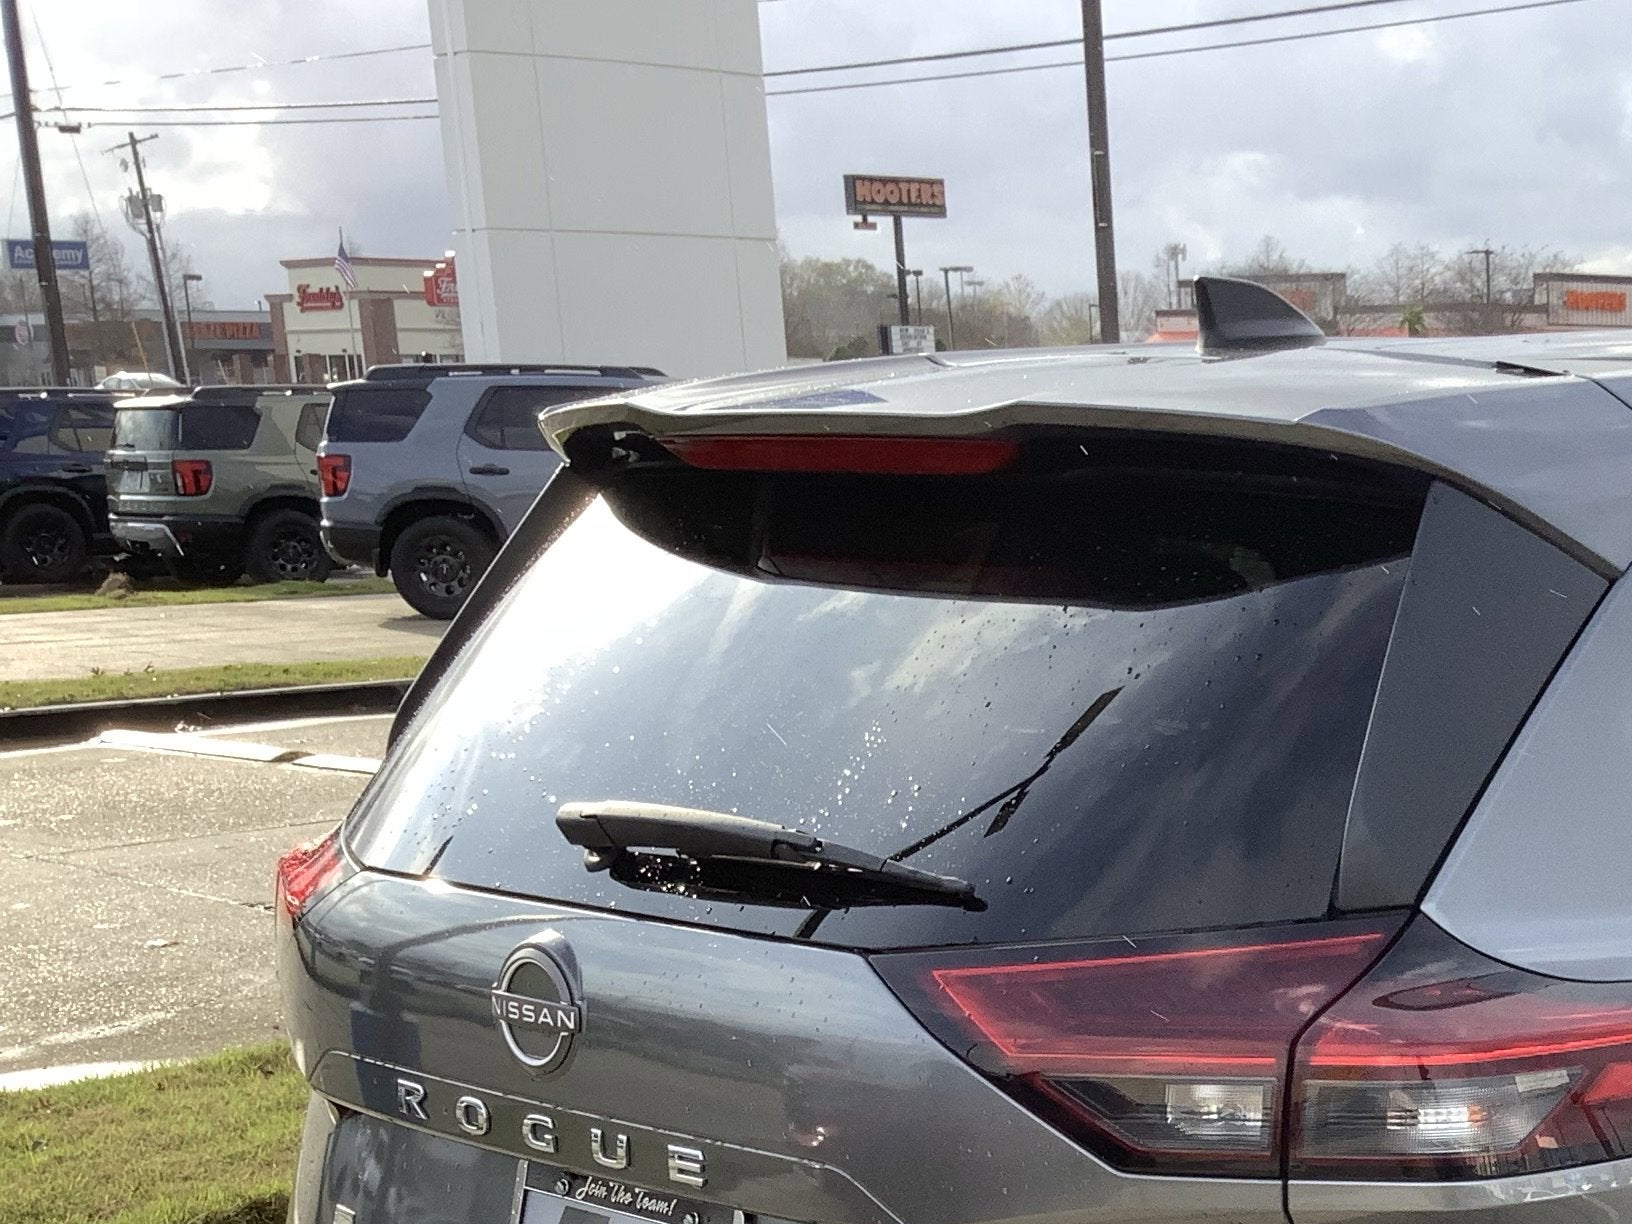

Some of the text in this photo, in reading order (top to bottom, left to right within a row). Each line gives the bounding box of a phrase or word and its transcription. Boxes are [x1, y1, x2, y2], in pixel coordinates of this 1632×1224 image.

[855, 178, 944, 206] HOOTERS
[14, 244, 83, 264] Acemy
[491, 995, 575, 1030] NISSAN
[397, 1078, 710, 1189] ROGUE
[575, 1176, 678, 1217] Join The Team!
